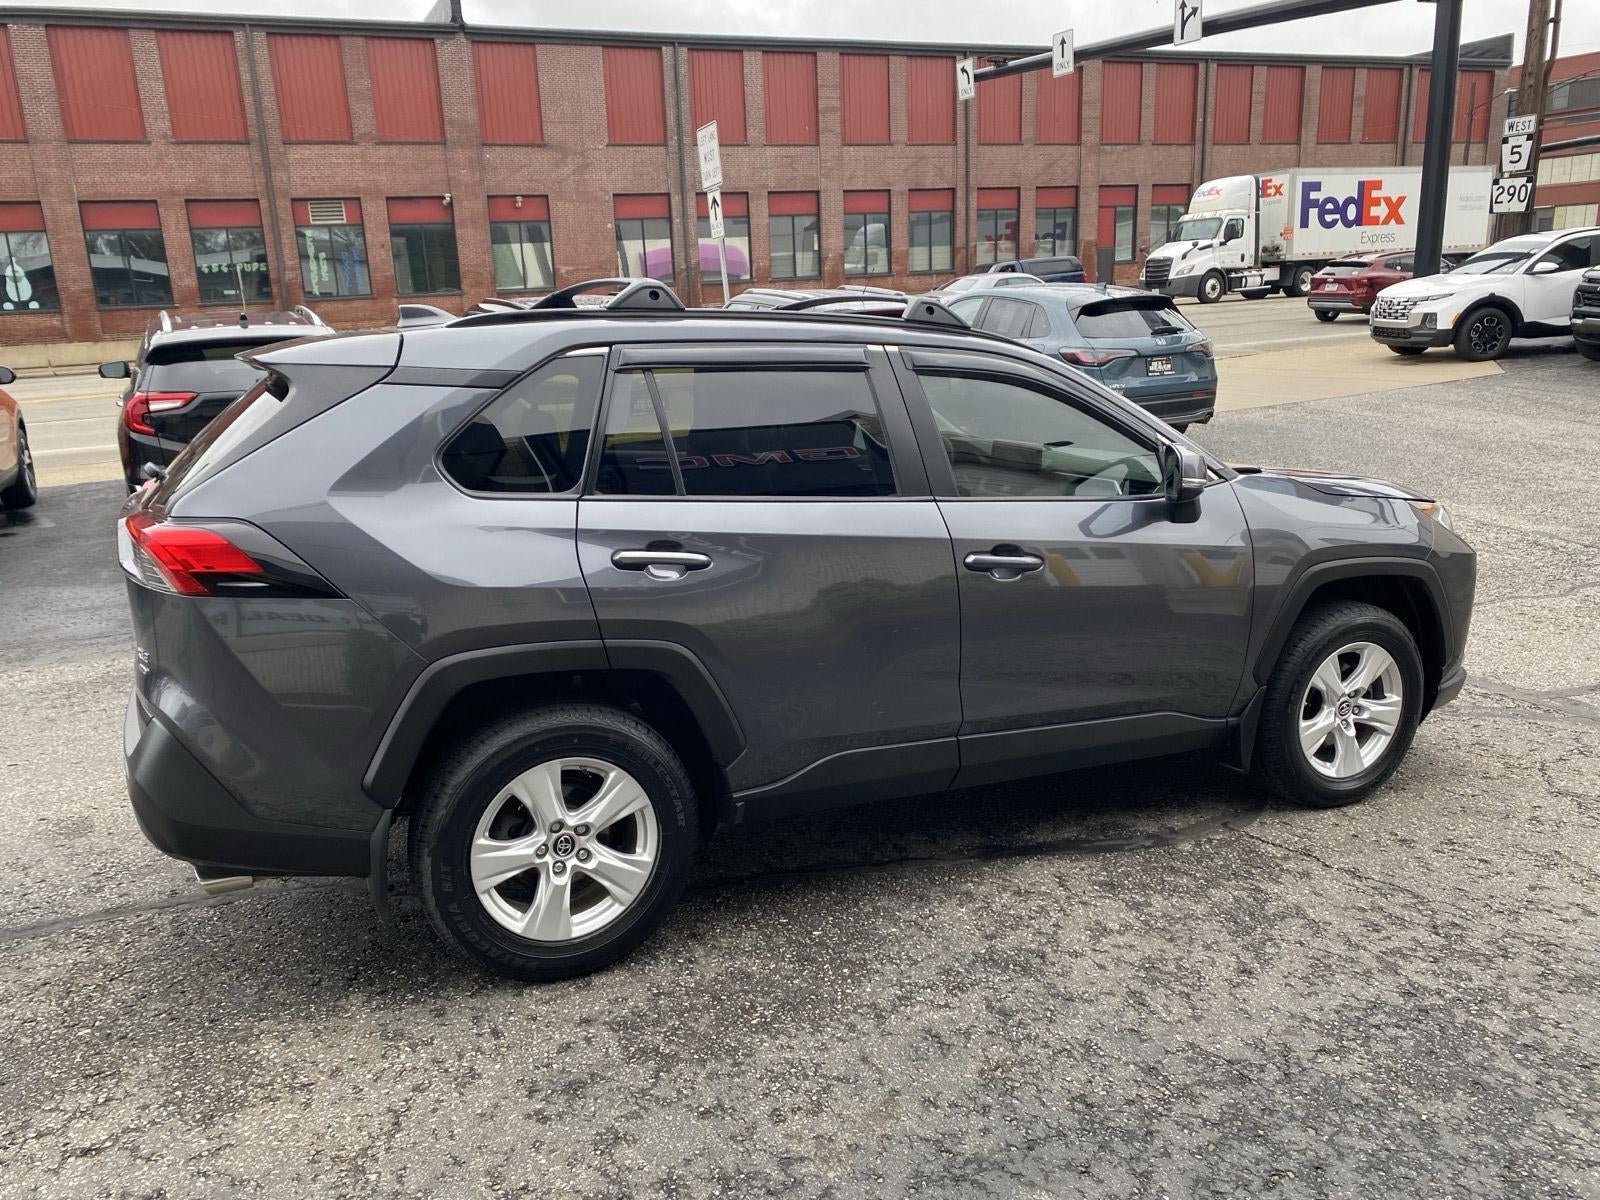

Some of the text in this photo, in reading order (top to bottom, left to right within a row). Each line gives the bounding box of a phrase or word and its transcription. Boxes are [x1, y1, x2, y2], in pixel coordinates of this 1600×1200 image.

[1055, 60, 1070, 72] ONLY
[960, 87, 972, 97] ONLY
[1508, 120, 1532, 132] WEST
[1508, 144, 1523, 164] 5
[1494, 184, 1529, 204] 290
[1300, 180, 1407, 229] FedEx
[1361, 230, 1396, 246] Express
